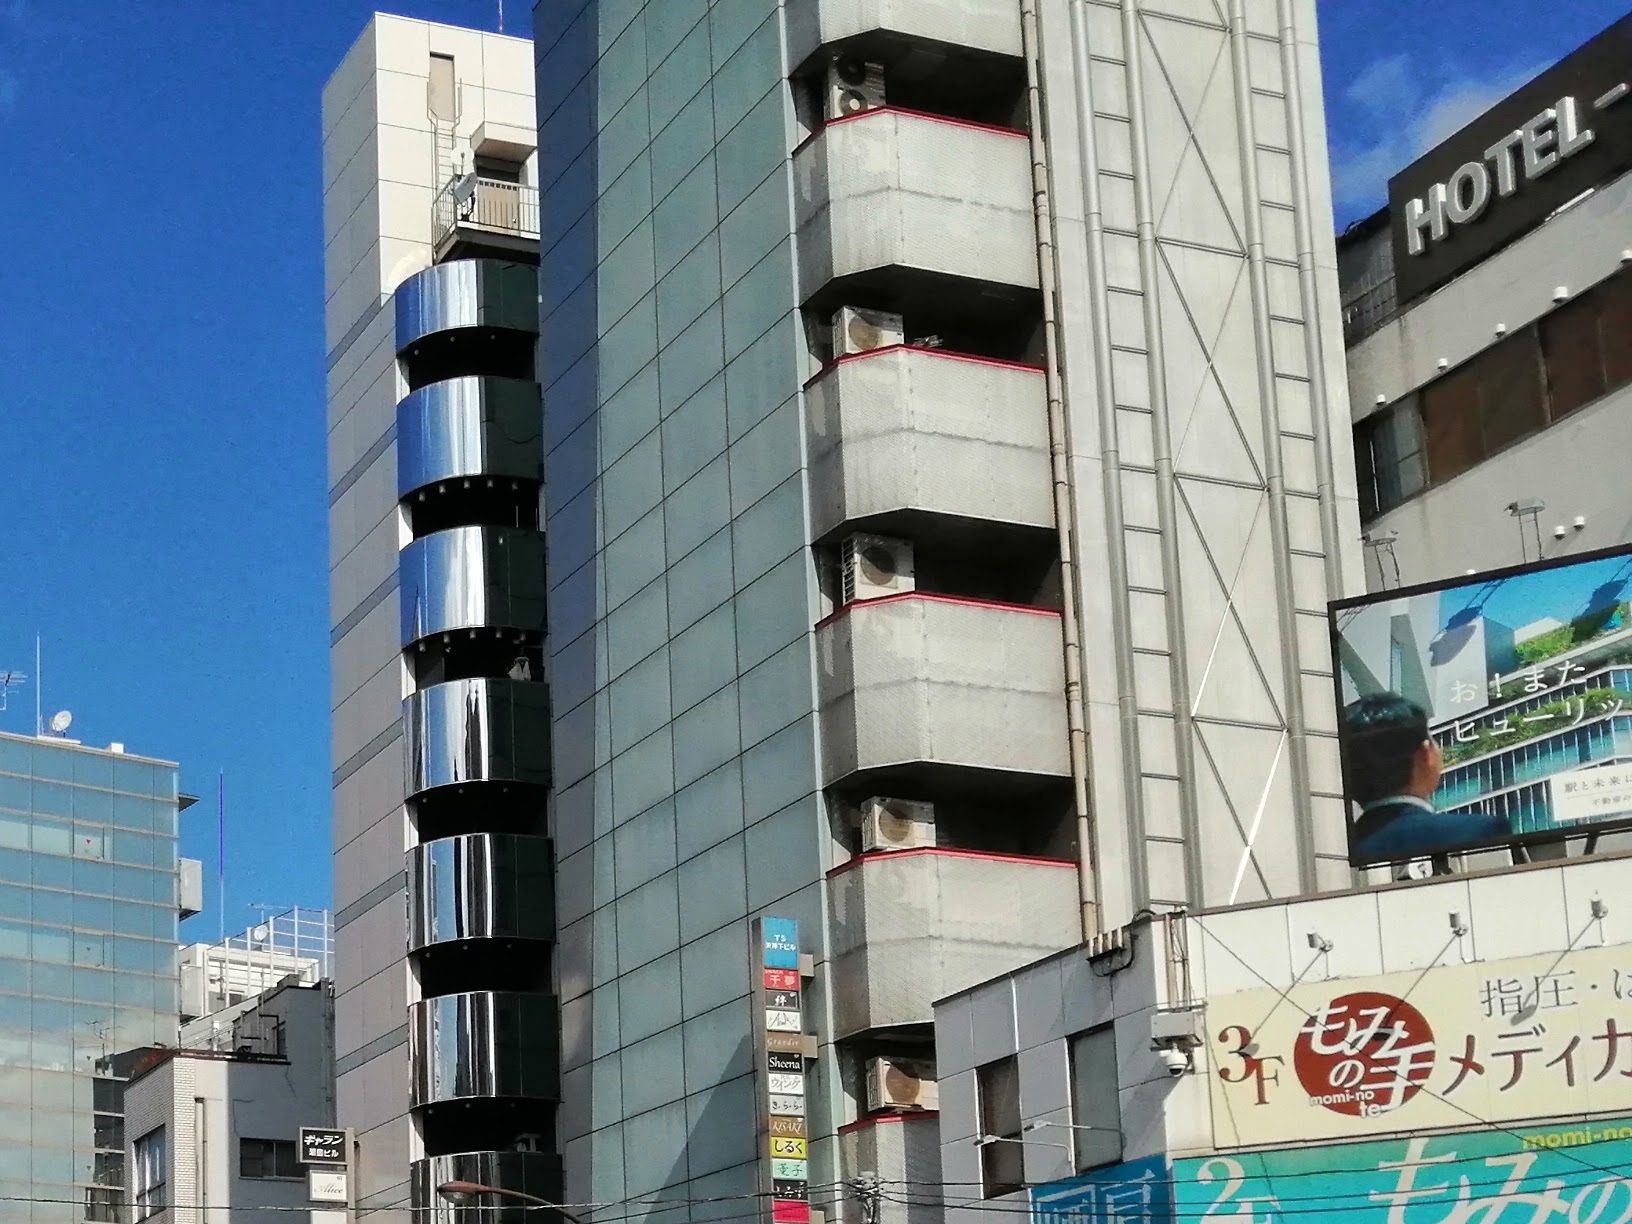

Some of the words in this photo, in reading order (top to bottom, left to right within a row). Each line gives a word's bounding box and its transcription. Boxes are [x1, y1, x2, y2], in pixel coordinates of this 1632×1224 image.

[1405, 95, 1597, 256] HOTEL
[1454, 698, 1624, 742] ヒューリッ
[769, 1056, 801, 1070] Sheena
[1218, 1024, 1284, 1106] 3F
[1442, 1017, 1632, 1097] メディカ
[304, 1134, 344, 1146] ギャラン
[772, 1121, 803, 1135] KISAKI
[774, 1139, 803, 1154] しるく
